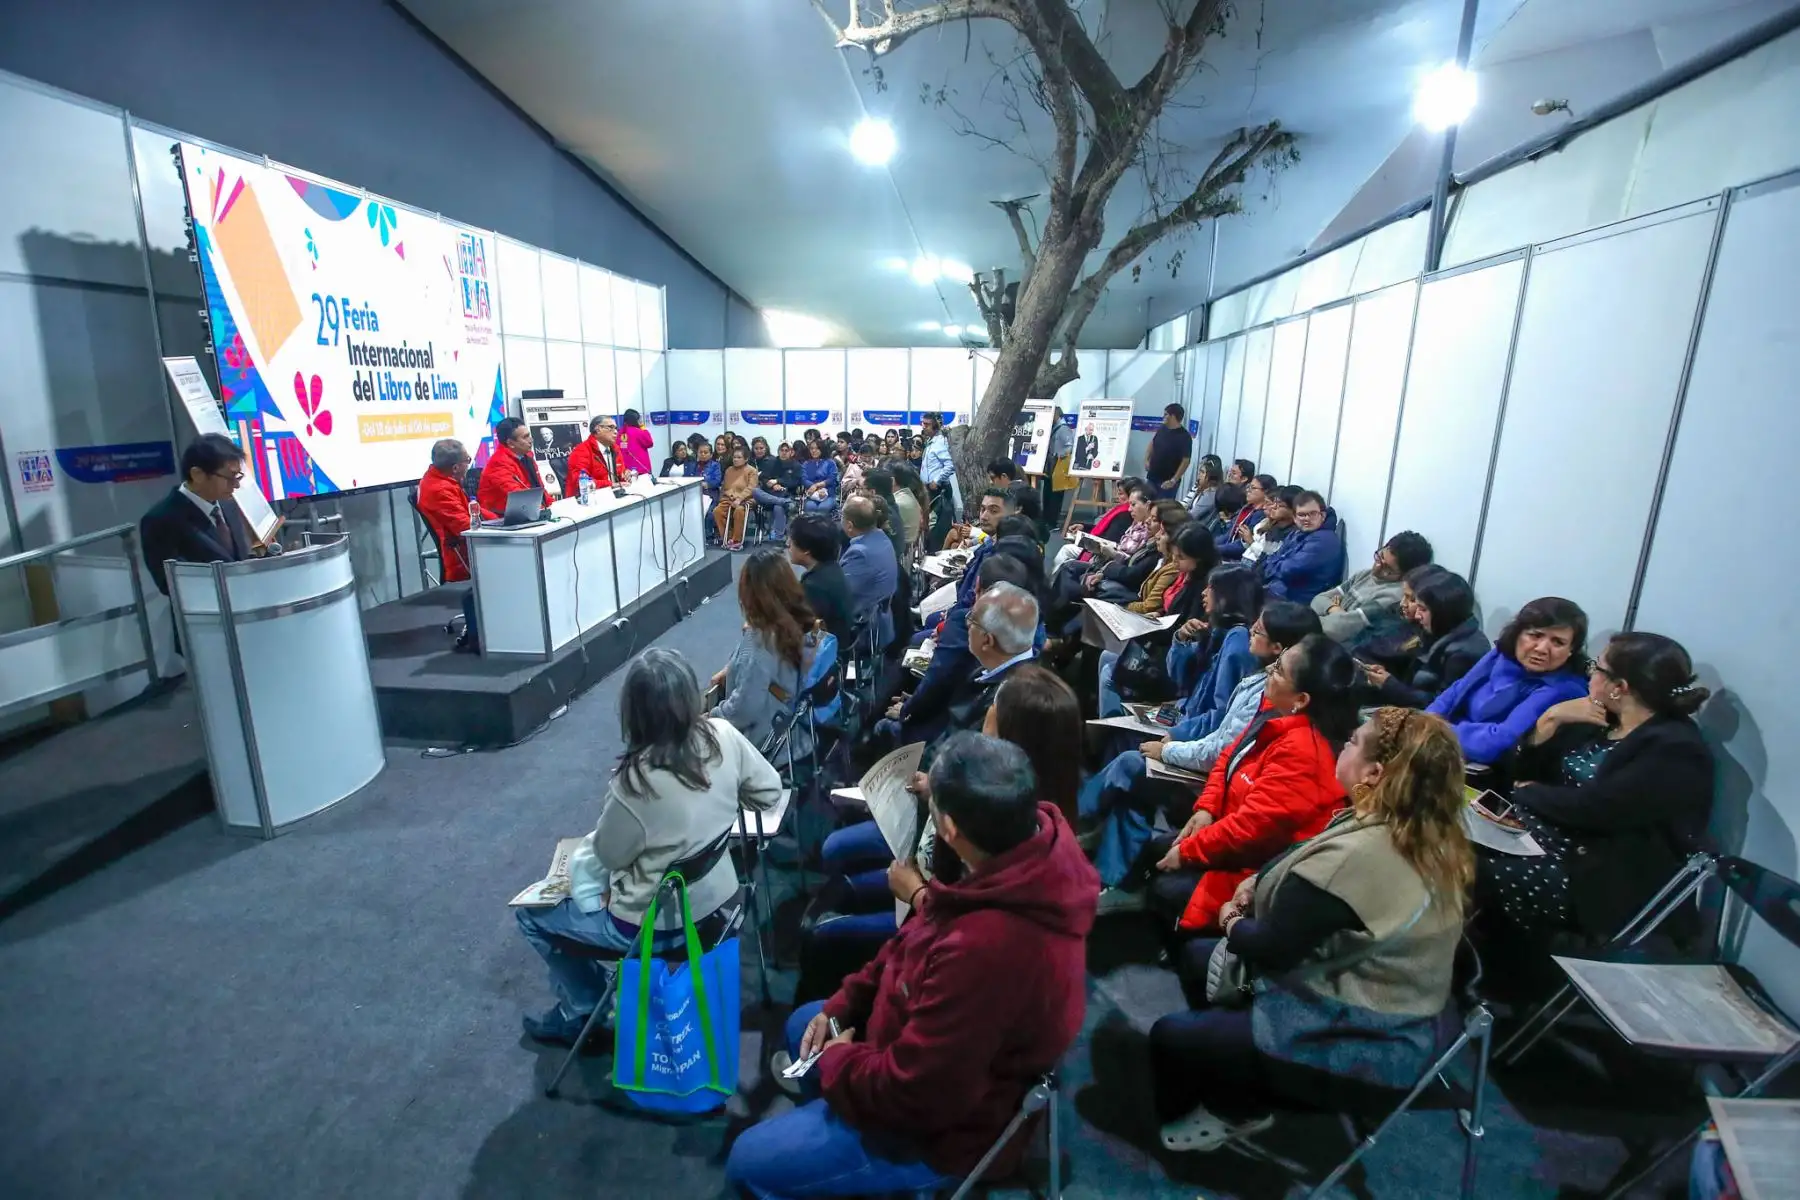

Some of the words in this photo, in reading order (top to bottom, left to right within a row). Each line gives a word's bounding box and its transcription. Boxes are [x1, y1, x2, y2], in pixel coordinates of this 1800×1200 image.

[311, 292, 340, 347] 29
[341, 297, 380, 332] Feria
[346, 334, 434, 369] Internacional
[352, 370, 376, 402] del
[376, 371, 412, 401] Libro
[414, 372, 430, 401] de
[431, 373, 458, 400] Lima
